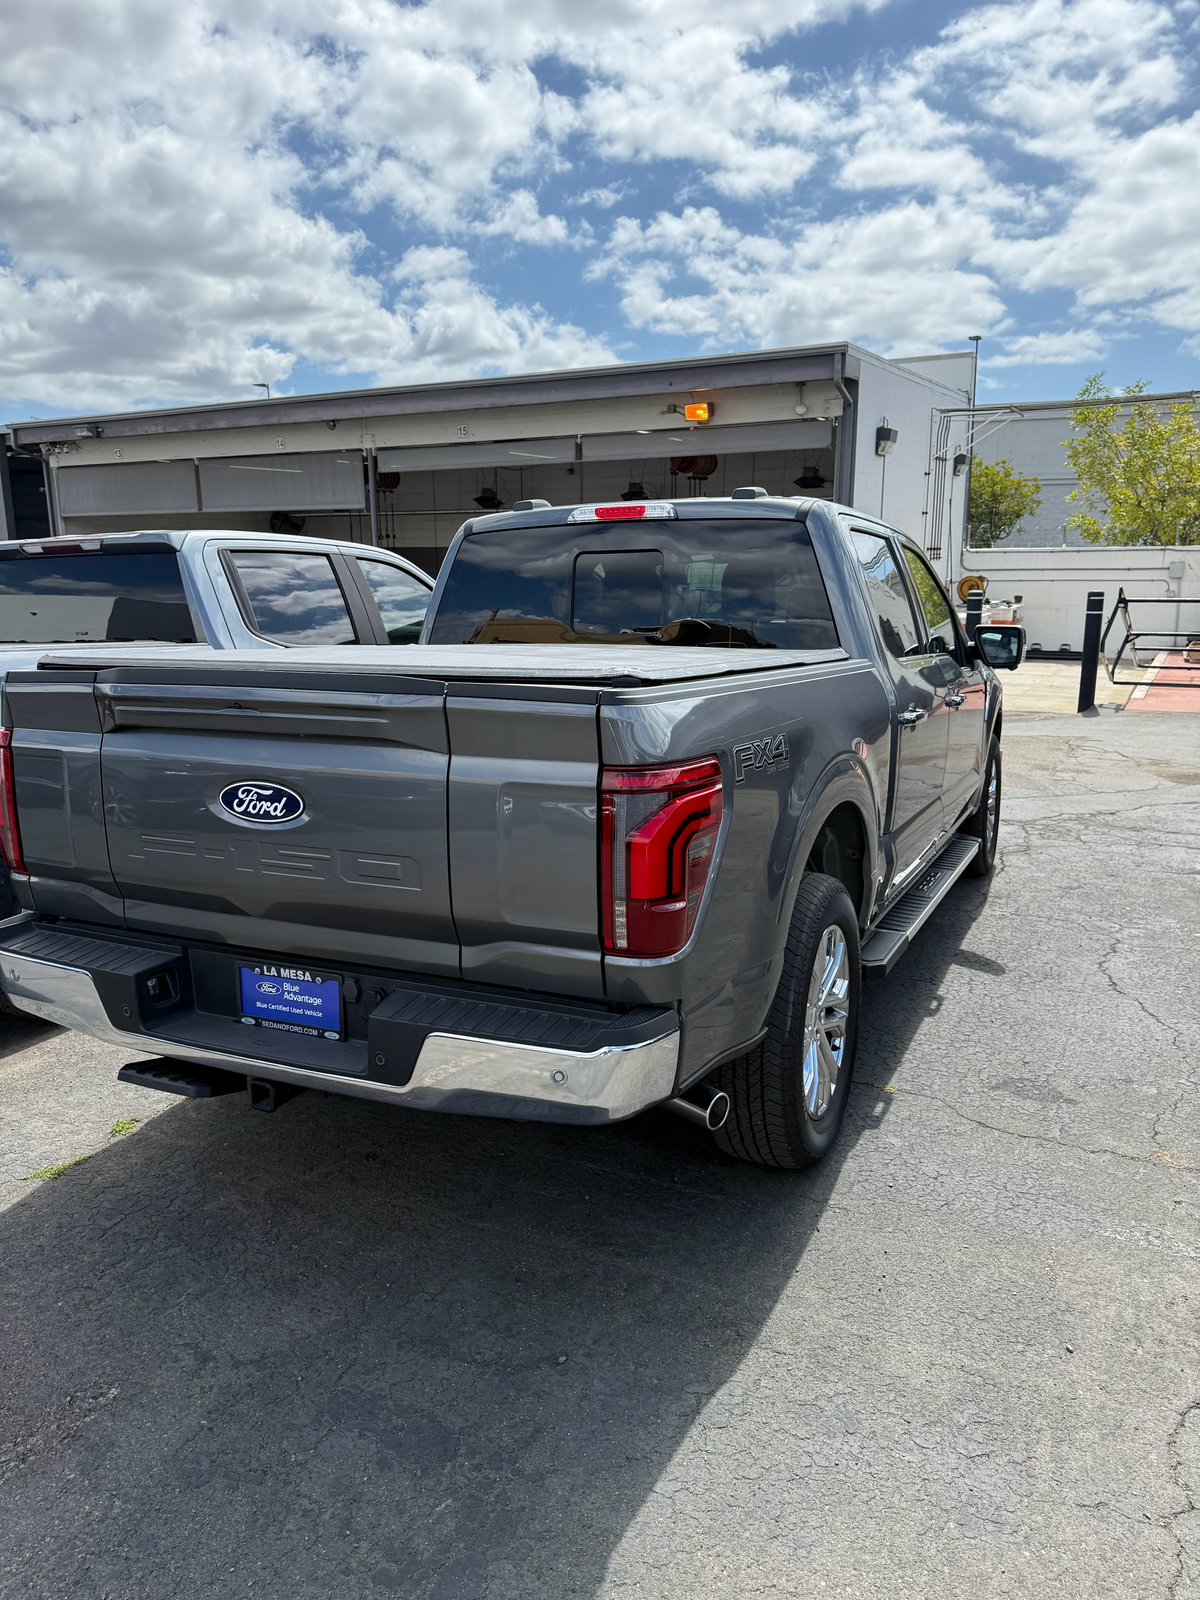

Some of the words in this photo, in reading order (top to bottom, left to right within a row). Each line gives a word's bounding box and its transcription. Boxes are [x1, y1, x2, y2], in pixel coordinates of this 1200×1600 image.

[458, 425, 468, 437] 15
[276, 437, 284, 448] 14
[733, 733, 790, 785] FX4
[233, 786, 287, 817] Ford
[263, 965, 278, 977] LA
[280, 968, 312, 982] MESA
[283, 982, 300, 993] Blue
[283, 991, 323, 1006] Advantage
[256, 1001, 268, 1009] Blue
[268, 1003, 290, 1012] Certified
[290, 1006, 304, 1015] Used
[304, 1008, 323, 1017] Vehicle
[261, 1020, 318, 1036] SEDANOFORD.COM
